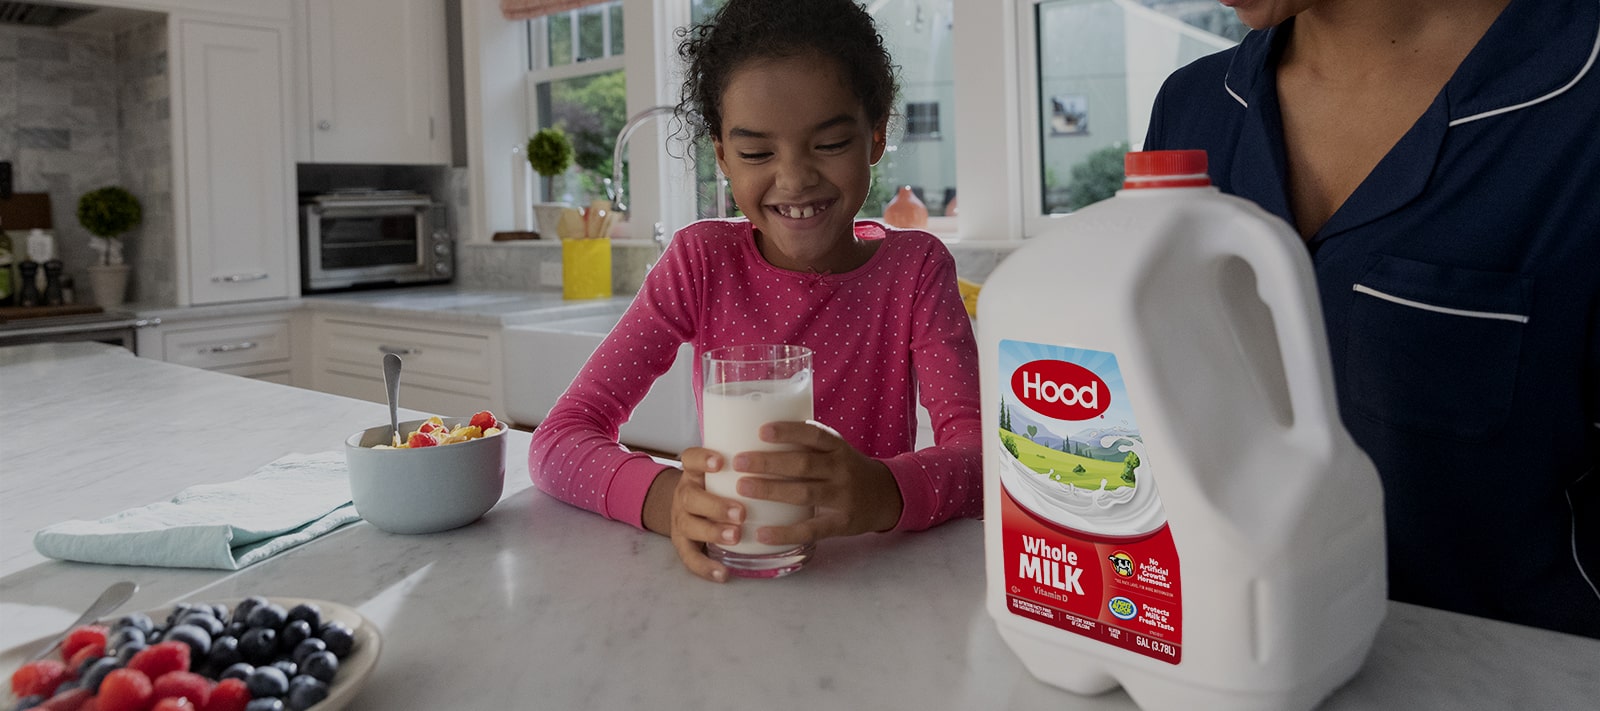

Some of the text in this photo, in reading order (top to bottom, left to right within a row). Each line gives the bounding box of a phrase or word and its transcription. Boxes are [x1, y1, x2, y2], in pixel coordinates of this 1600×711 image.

[1022, 371, 1098, 409] Hood
[1022, 534, 1078, 566] Whole
[1140, 563, 1168, 576] Artificial
[1149, 558, 1158, 566] No
[1019, 553, 1085, 595] MILK
[1142, 570, 1166, 581] Growth
[1033, 586, 1061, 601] Vitamin
[1062, 594, 1069, 602] D
[1142, 603, 1169, 616] Protects
[1145, 611, 1167, 623] Milk &
[1139, 616, 1174, 632] Fresh Taste
[1136, 636, 1175, 657] GAL (3.78L)
